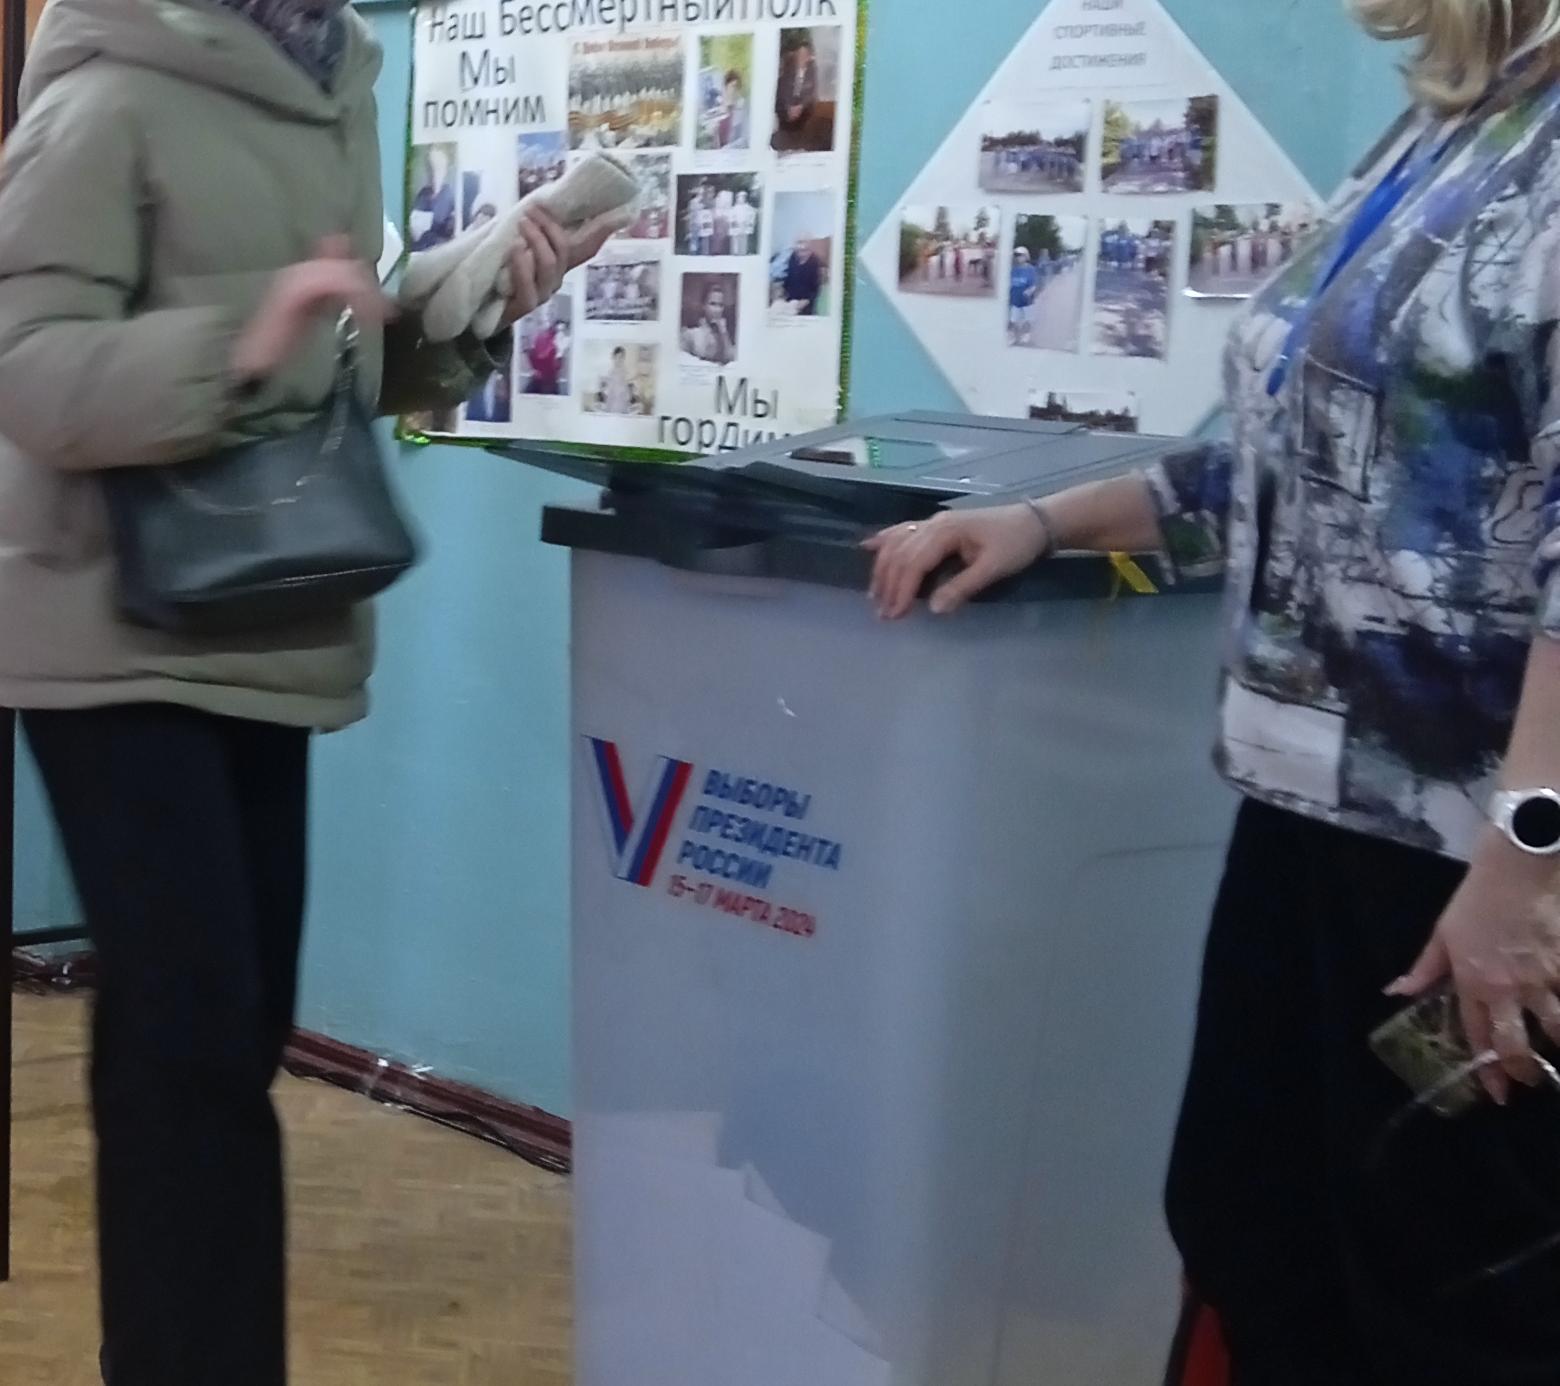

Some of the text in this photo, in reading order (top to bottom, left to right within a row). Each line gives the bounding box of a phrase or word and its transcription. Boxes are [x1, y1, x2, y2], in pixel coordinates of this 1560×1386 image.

[428, 6, 486, 43] Наш
[458, 48, 517, 90] Мы
[423, 94, 546, 129] помним
[715, 375, 779, 419] Мы
[658, 415, 790, 455] горди
[702, 768, 812, 821] ВЫБОРЫ
[688, 804, 843, 871] ПРЕЗИДЕНТА
[676, 839, 773, 889] РОССИИ
